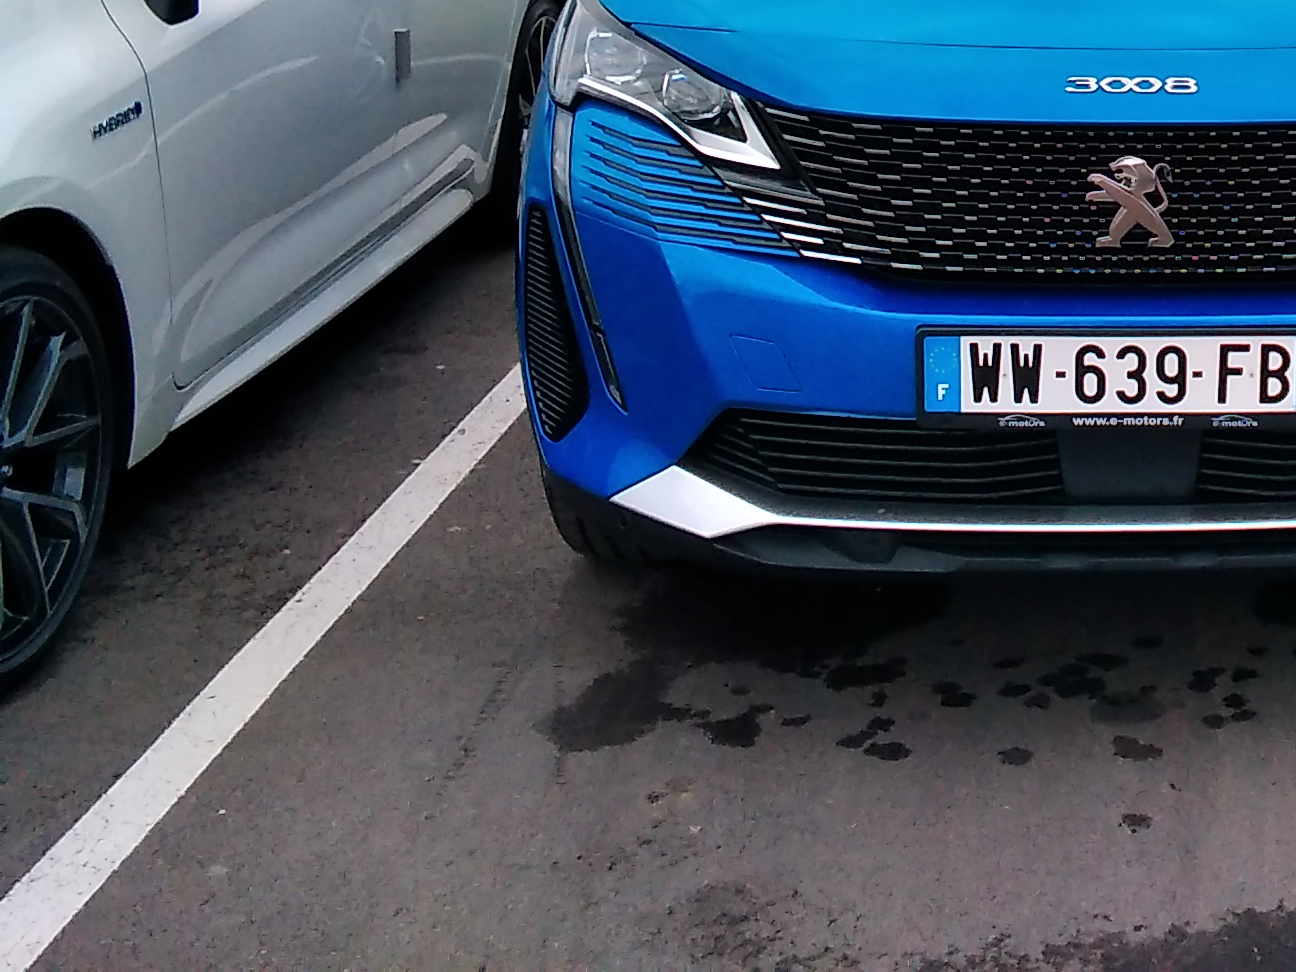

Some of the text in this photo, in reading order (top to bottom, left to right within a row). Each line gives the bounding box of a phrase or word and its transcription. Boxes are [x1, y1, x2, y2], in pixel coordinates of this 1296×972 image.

[1064, 75, 1199, 94] 3008
[90, 101, 142, 140] HYBRID
[936, 383, 949, 401] F
[1072, 415, 1185, 427] www.e-motors.fr
